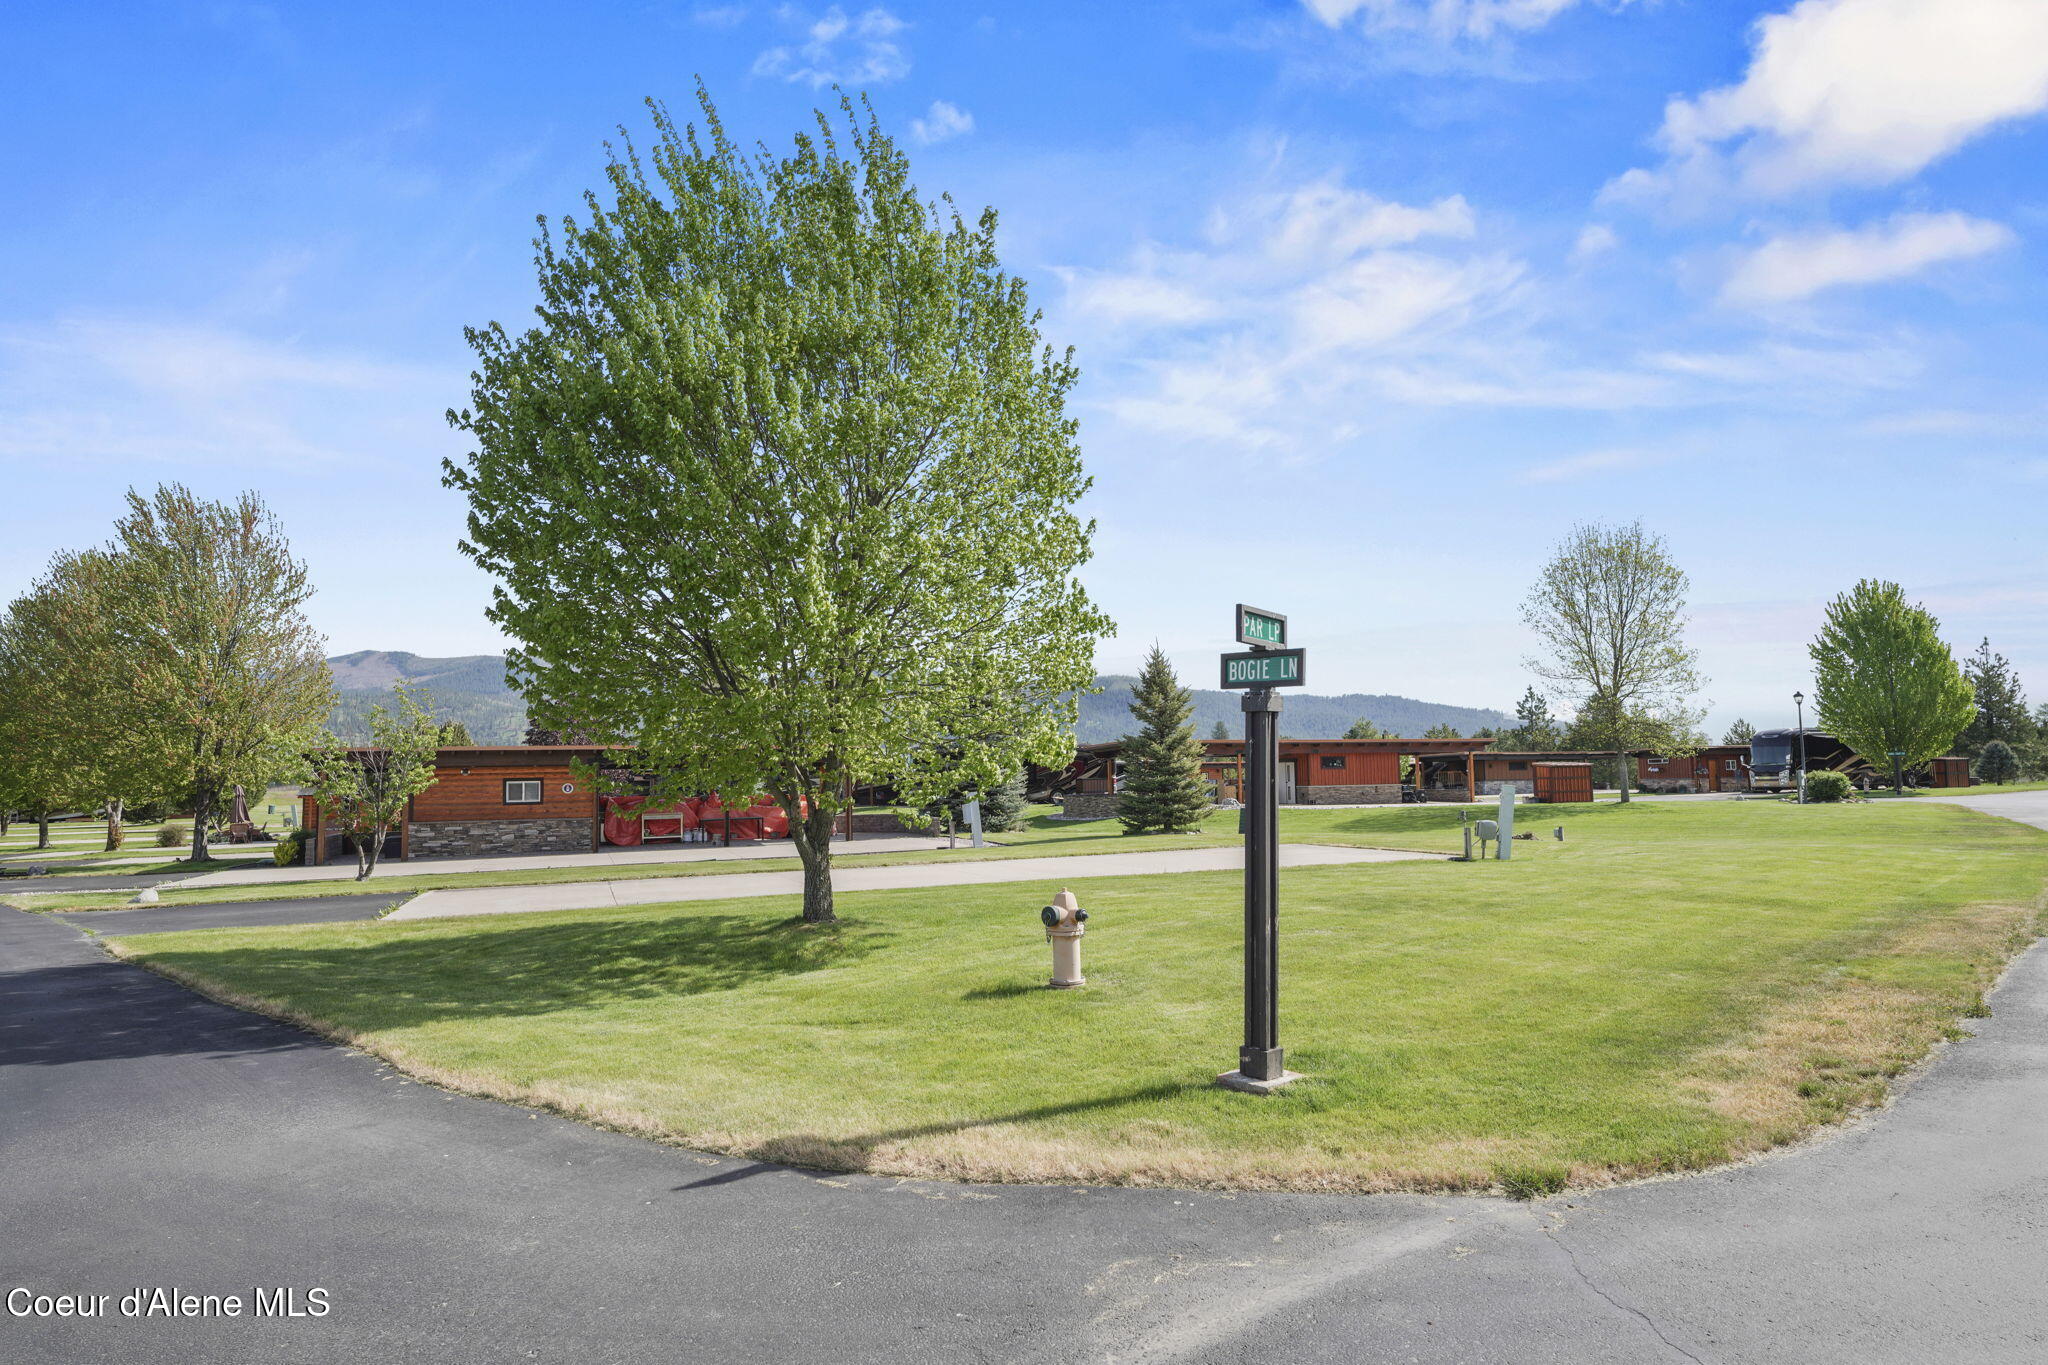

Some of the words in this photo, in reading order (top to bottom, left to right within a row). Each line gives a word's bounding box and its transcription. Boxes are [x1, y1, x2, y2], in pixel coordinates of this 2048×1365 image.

[1243, 615, 1263, 638] PAR
[1268, 620, 1280, 641] LP
[1229, 659, 1270, 681] BOGIE
[1280, 657, 1298, 678] LN
